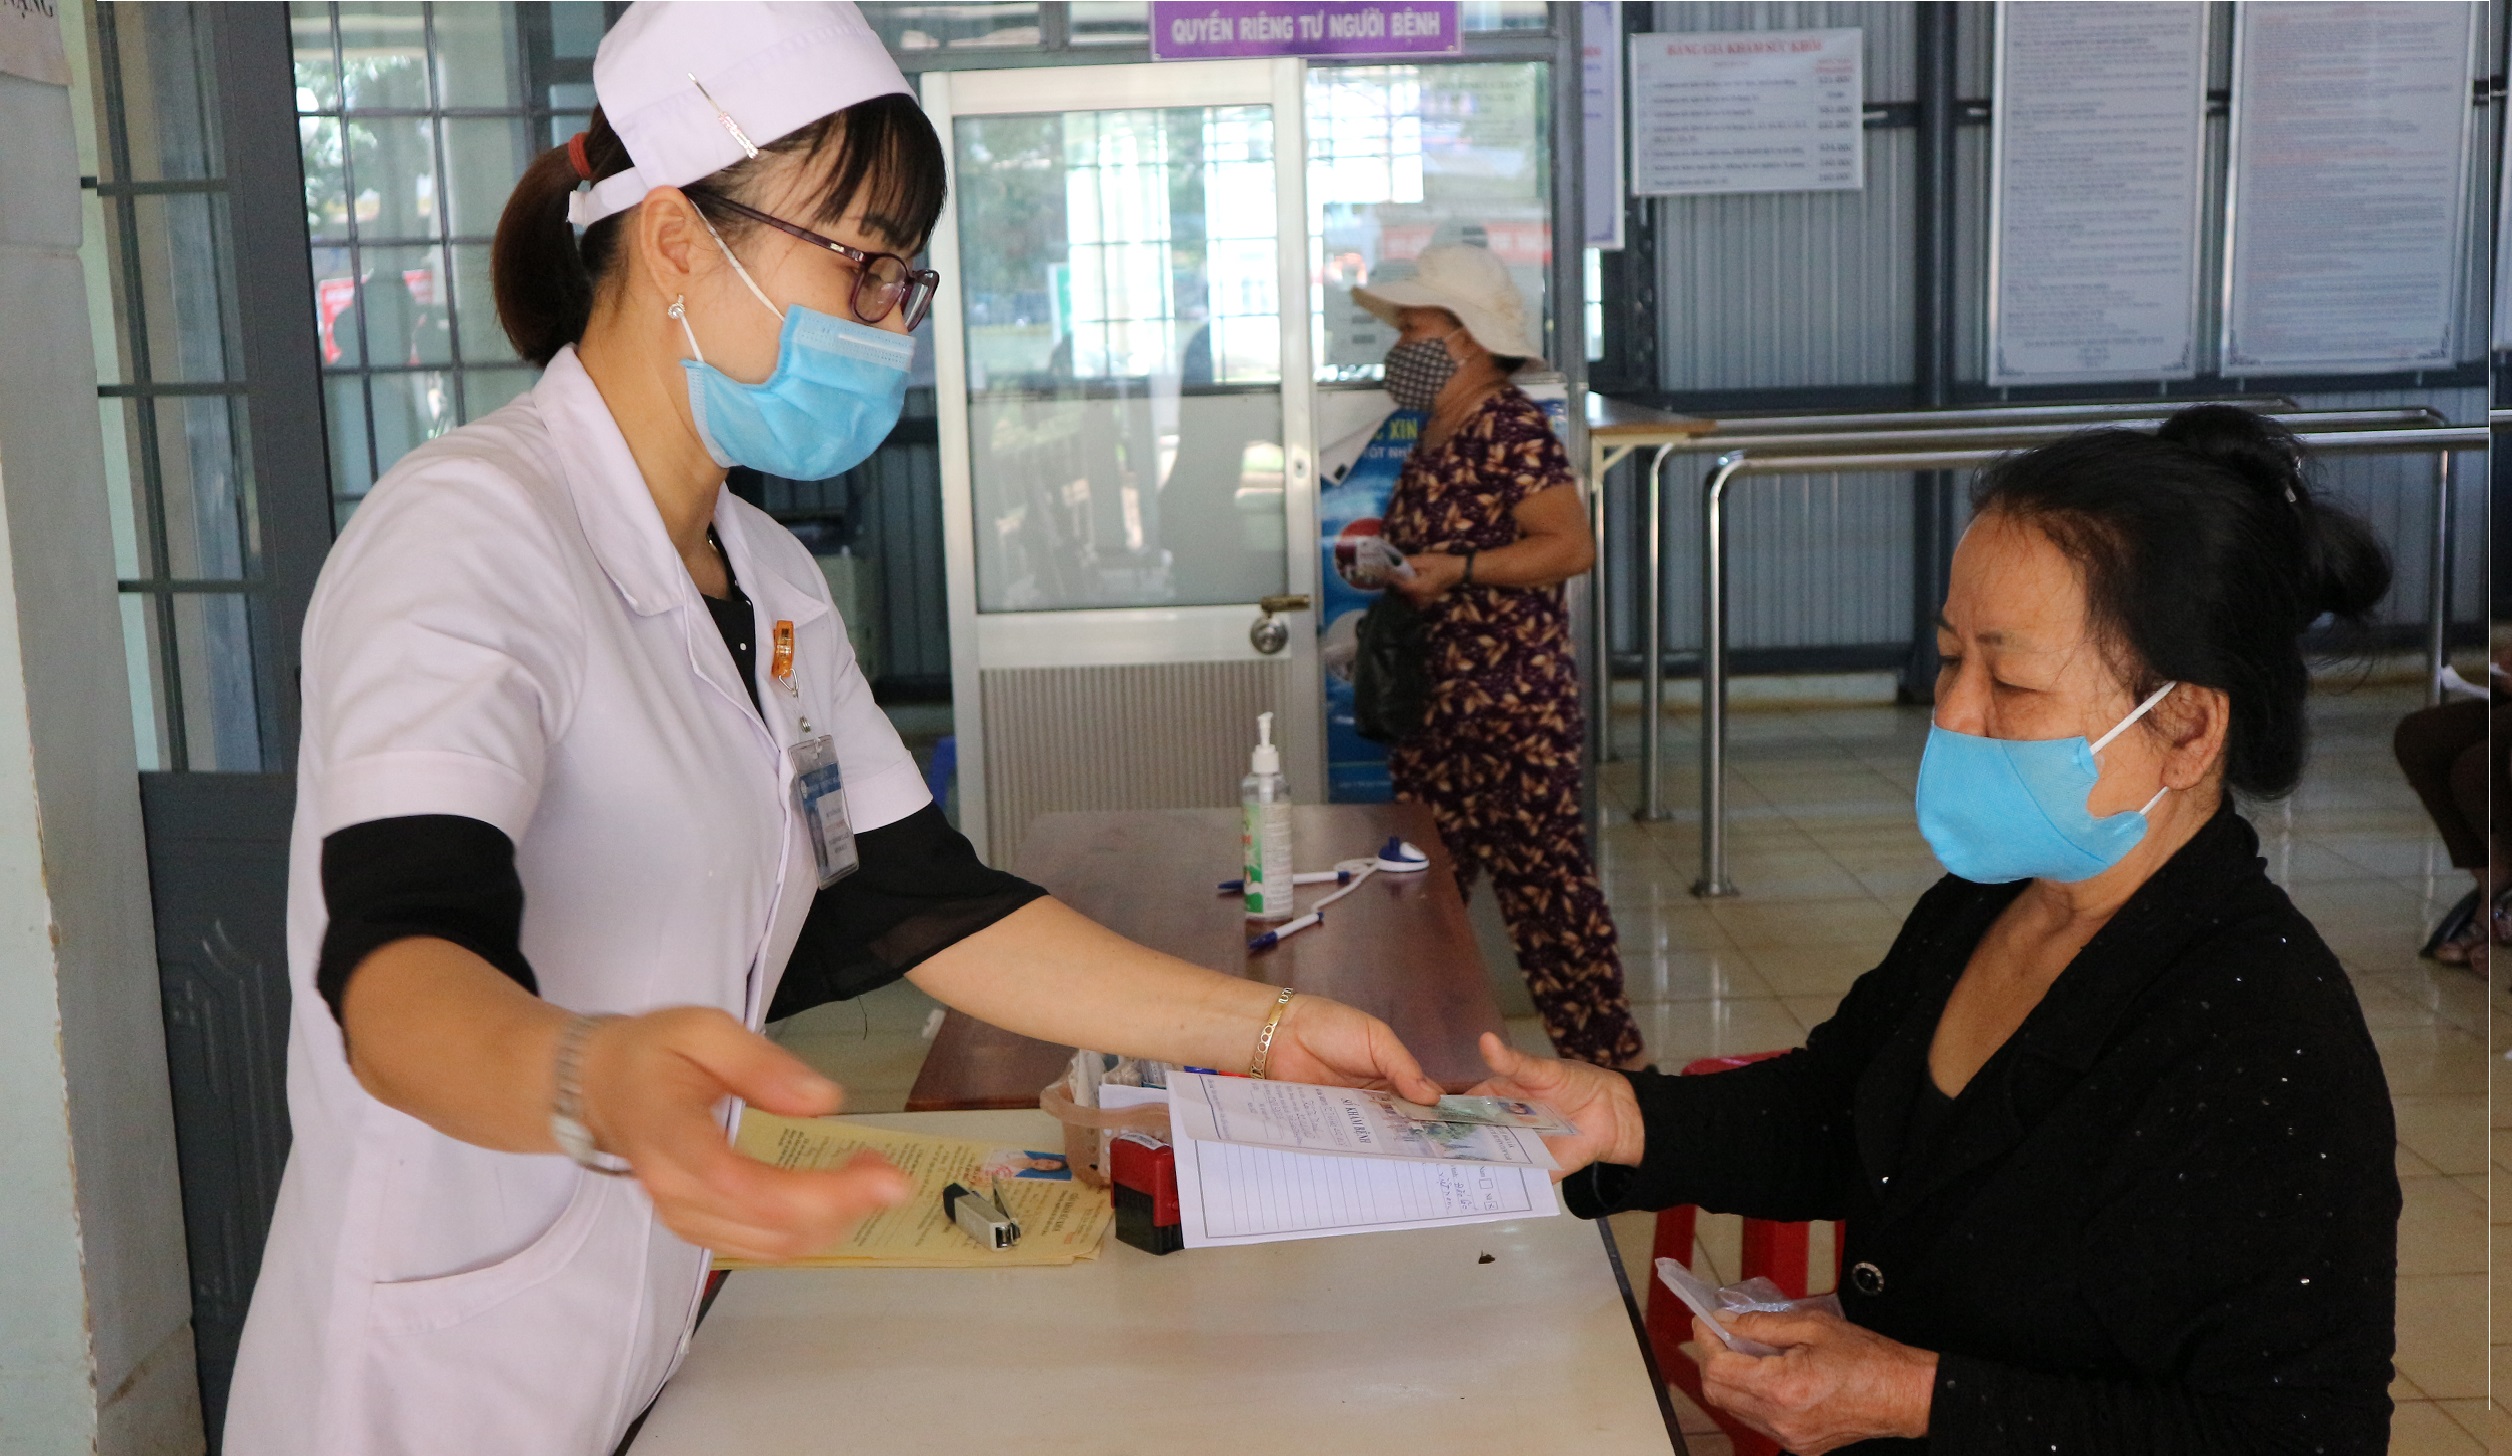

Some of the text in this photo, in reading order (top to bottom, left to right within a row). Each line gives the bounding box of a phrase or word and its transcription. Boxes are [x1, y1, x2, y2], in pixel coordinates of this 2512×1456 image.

[1239, 10, 1294, 41] RIÊNG
[1299, 9, 1325, 39] TƯ
[1329, 7, 1385, 37] NGƯỜI
[1391, 7, 1441, 45] BỆNH
[1345, 1107, 1364, 1125] KHÁM
[1354, 1127, 1371, 1143] BỆNH
